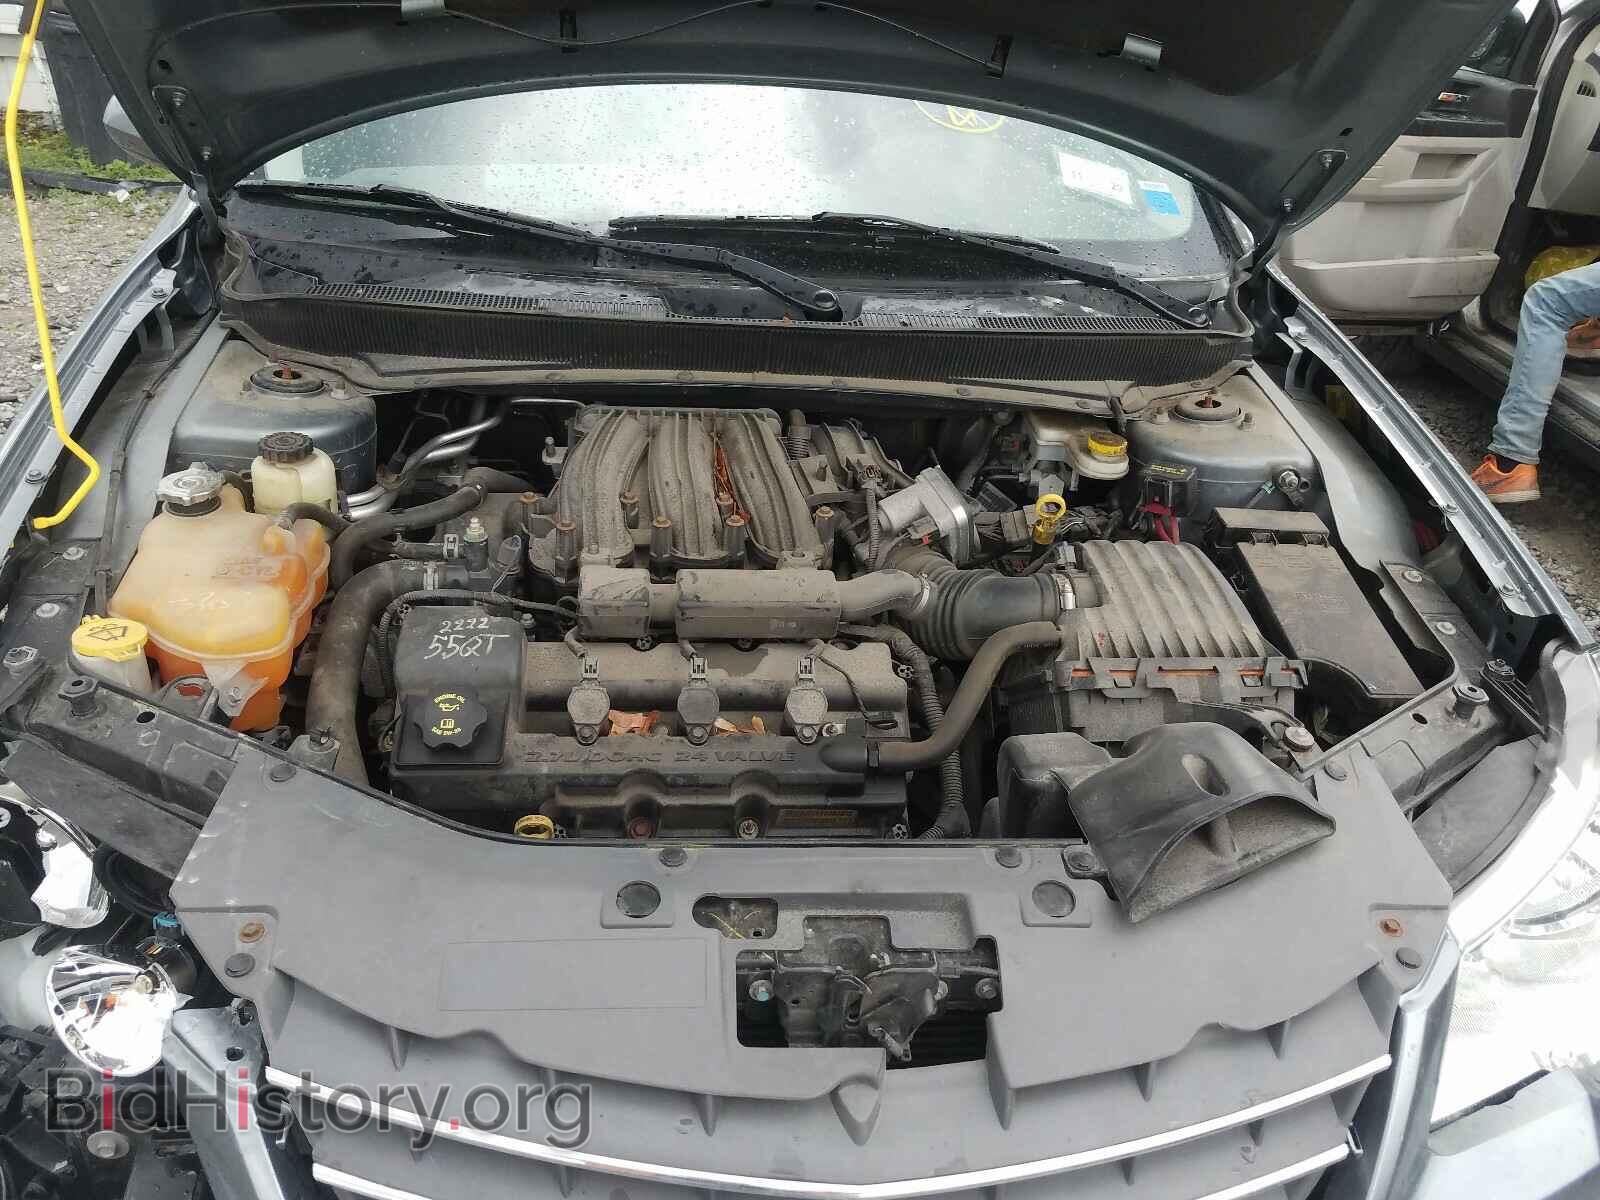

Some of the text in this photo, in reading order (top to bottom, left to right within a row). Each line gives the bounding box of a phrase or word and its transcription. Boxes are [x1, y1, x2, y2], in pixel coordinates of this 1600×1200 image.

[433, 693, 457, 704] ENGINE
[674, 751, 709, 763] 24
[714, 751, 798, 763] VALVE
